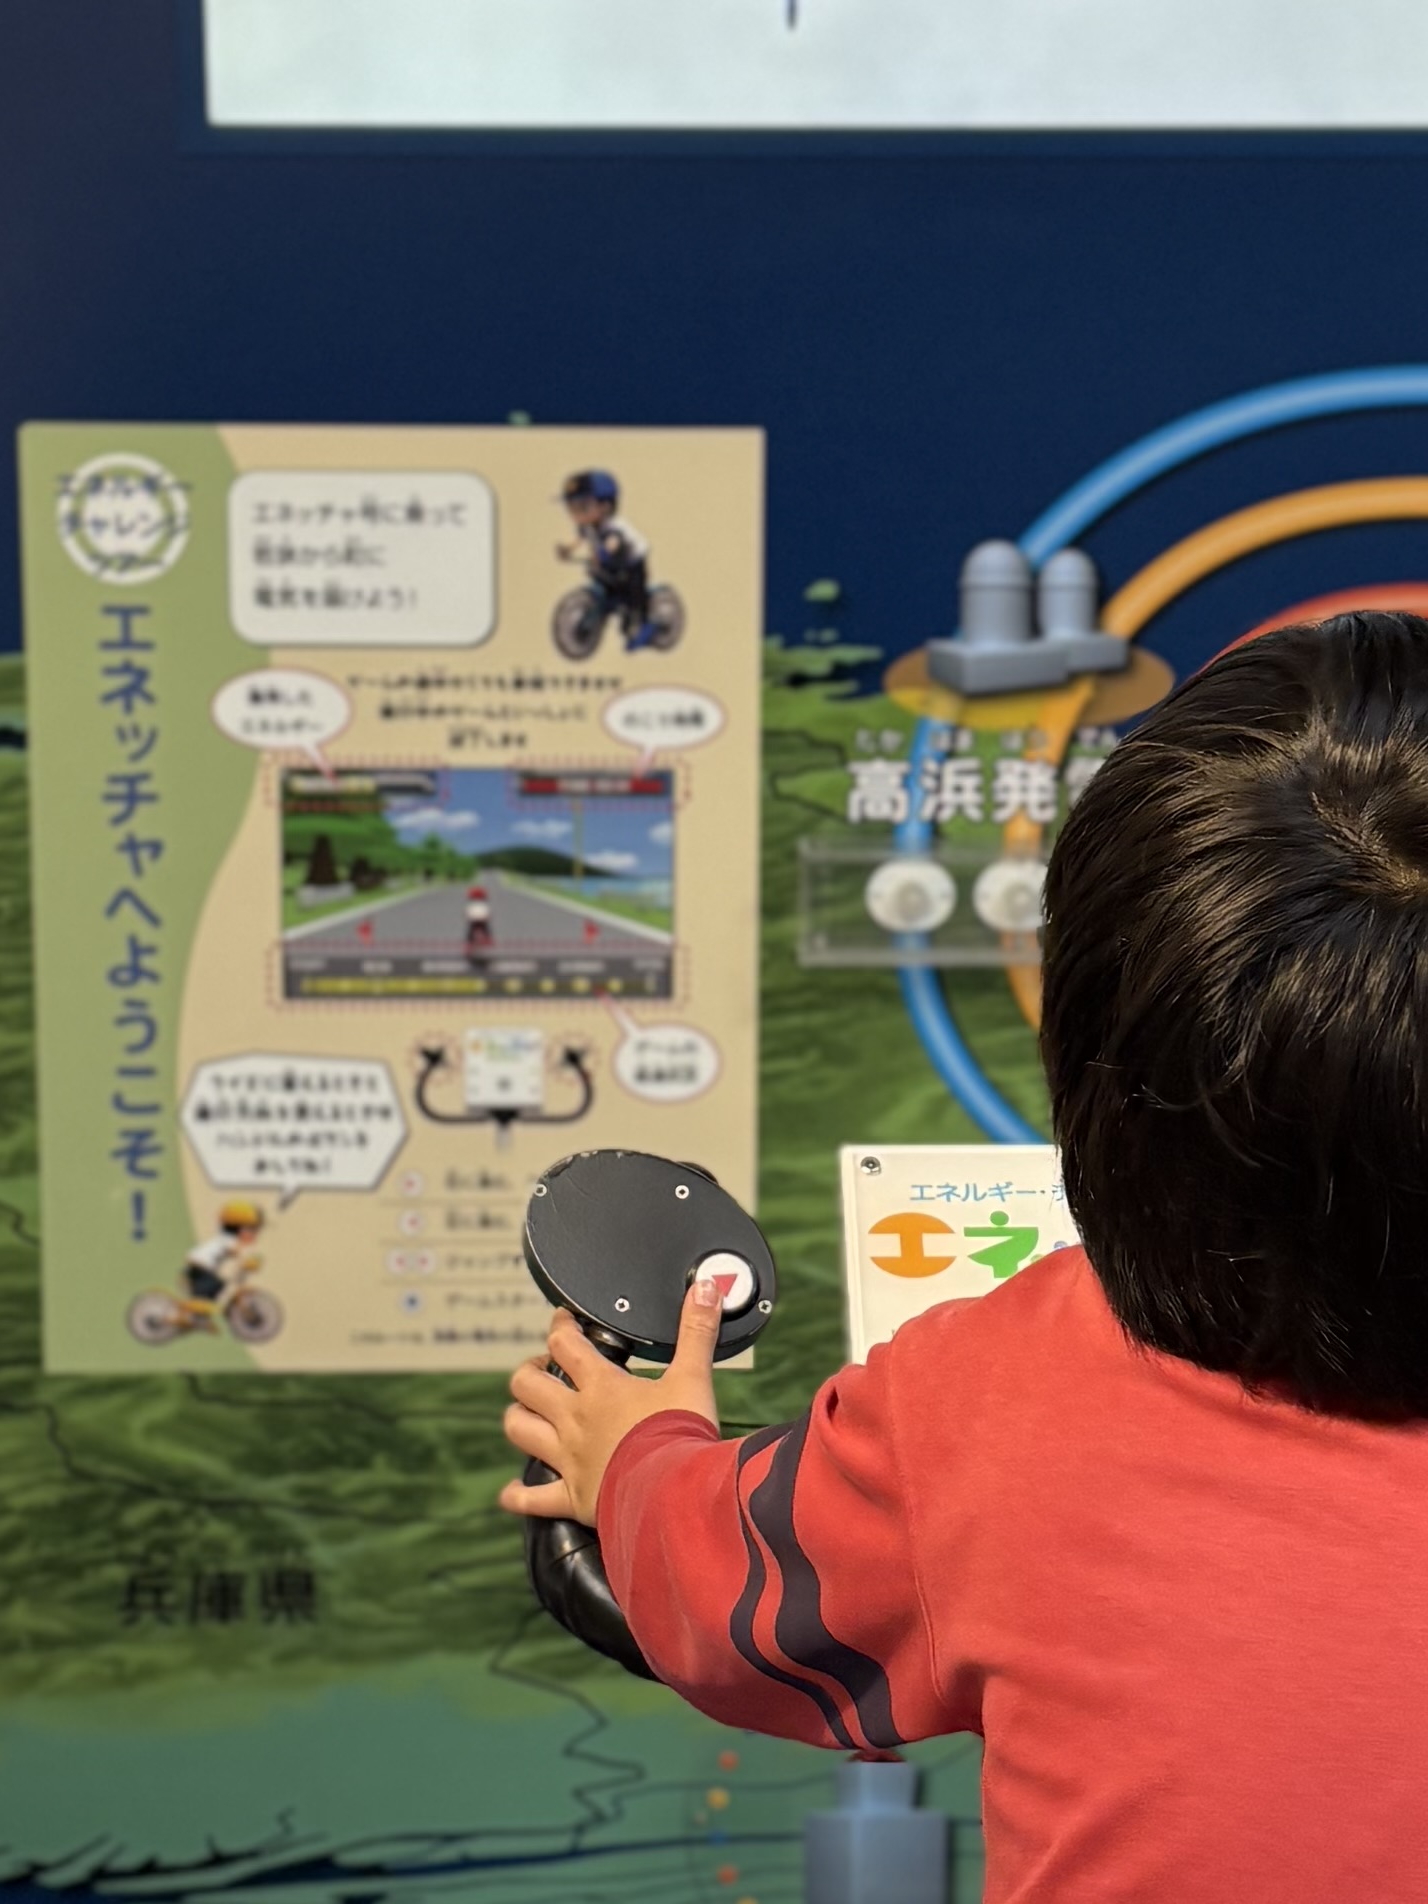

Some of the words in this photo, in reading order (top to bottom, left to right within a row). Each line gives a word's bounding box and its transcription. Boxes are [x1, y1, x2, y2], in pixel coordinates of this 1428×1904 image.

[99, 604, 164, 1243] エネッチャへようこそ!
[868, 1210, 1067, 1278] エネ
